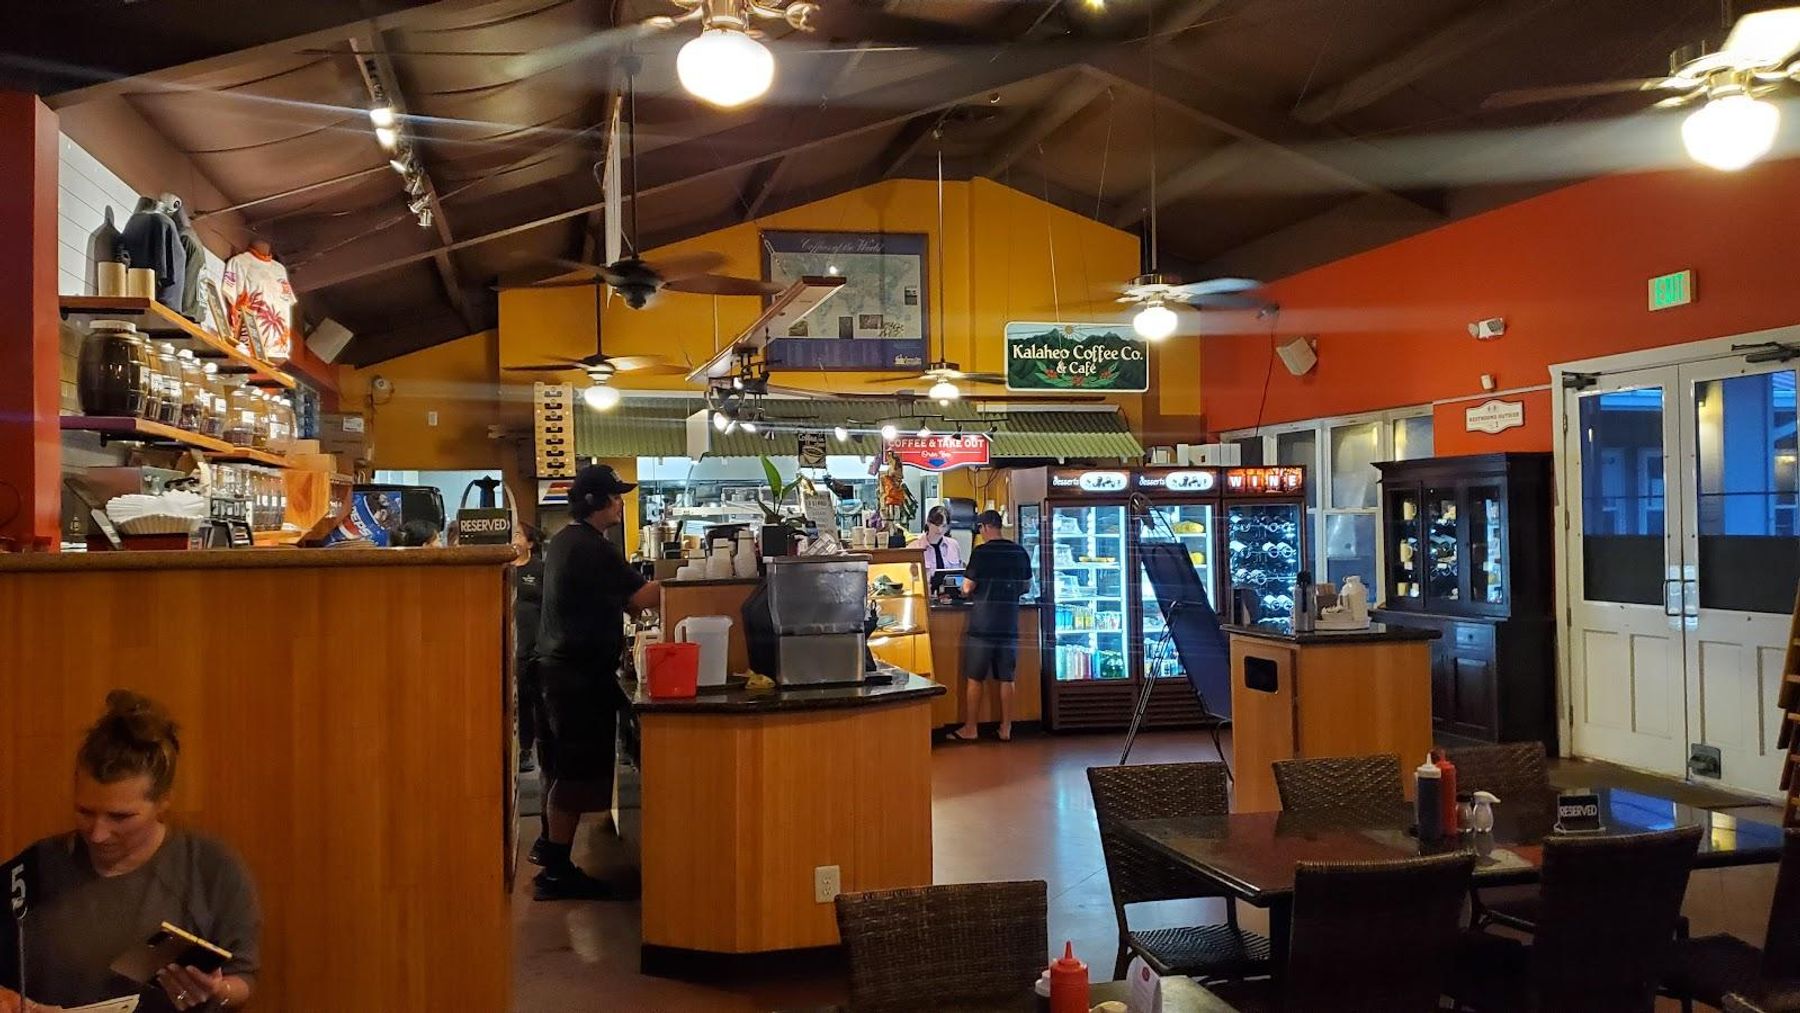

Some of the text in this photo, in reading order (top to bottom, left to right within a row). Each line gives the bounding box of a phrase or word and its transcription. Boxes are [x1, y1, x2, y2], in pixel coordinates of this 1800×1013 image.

[1655, 273, 1684, 305] EXIT
[1012, 344, 1143, 363] Kalaheo Coffee Co.
[1056, 360, 1097, 376] & Café
[888, 439, 984, 448] COFFEE & TAKE OUT
[351, 505, 375, 541] PEPS
[460, 518, 507, 533] RESERVED
[1560, 804, 1597, 817] RESERVED
[11, 863, 26, 905] 5
